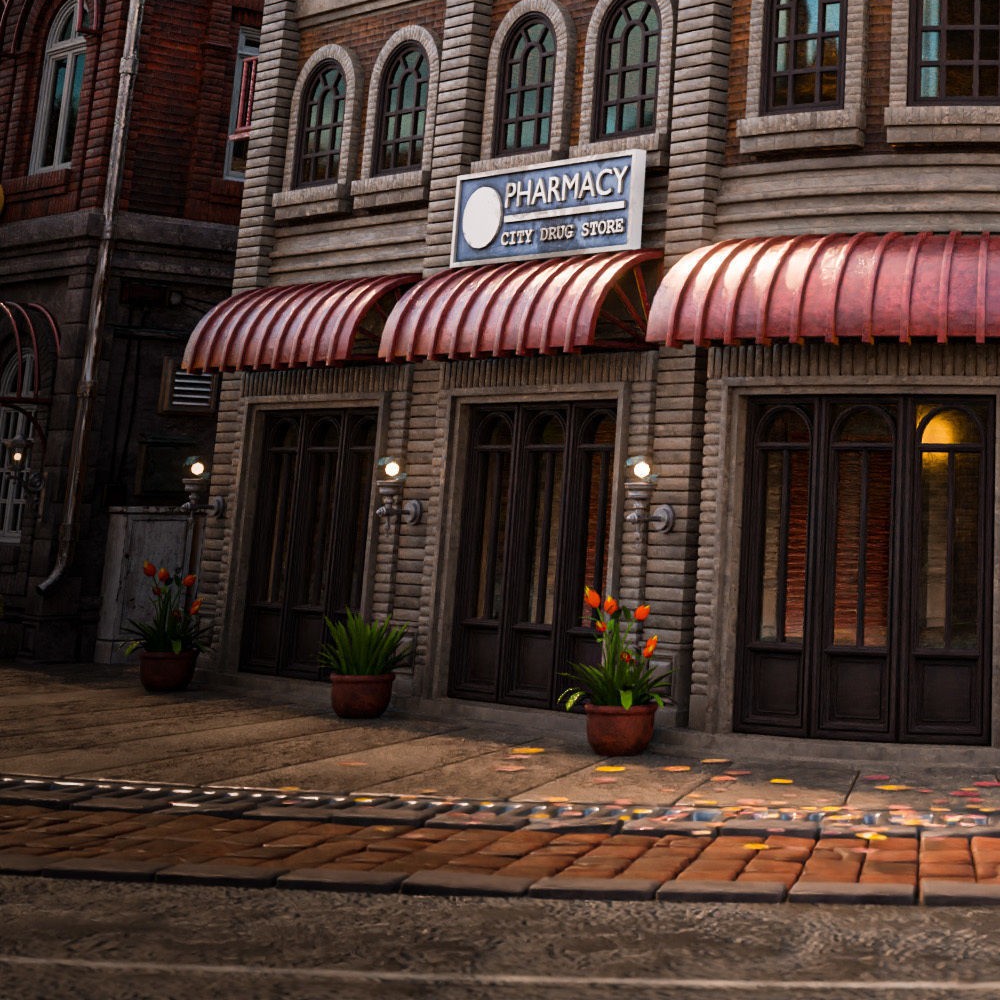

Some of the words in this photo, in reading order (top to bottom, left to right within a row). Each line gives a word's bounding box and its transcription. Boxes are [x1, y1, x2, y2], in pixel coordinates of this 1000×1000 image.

[504, 165, 629, 209] PHARMACY
[500, 229, 534, 246] CITY
[540, 224, 575, 241] DRUG
[581, 218, 624, 237] STORE
